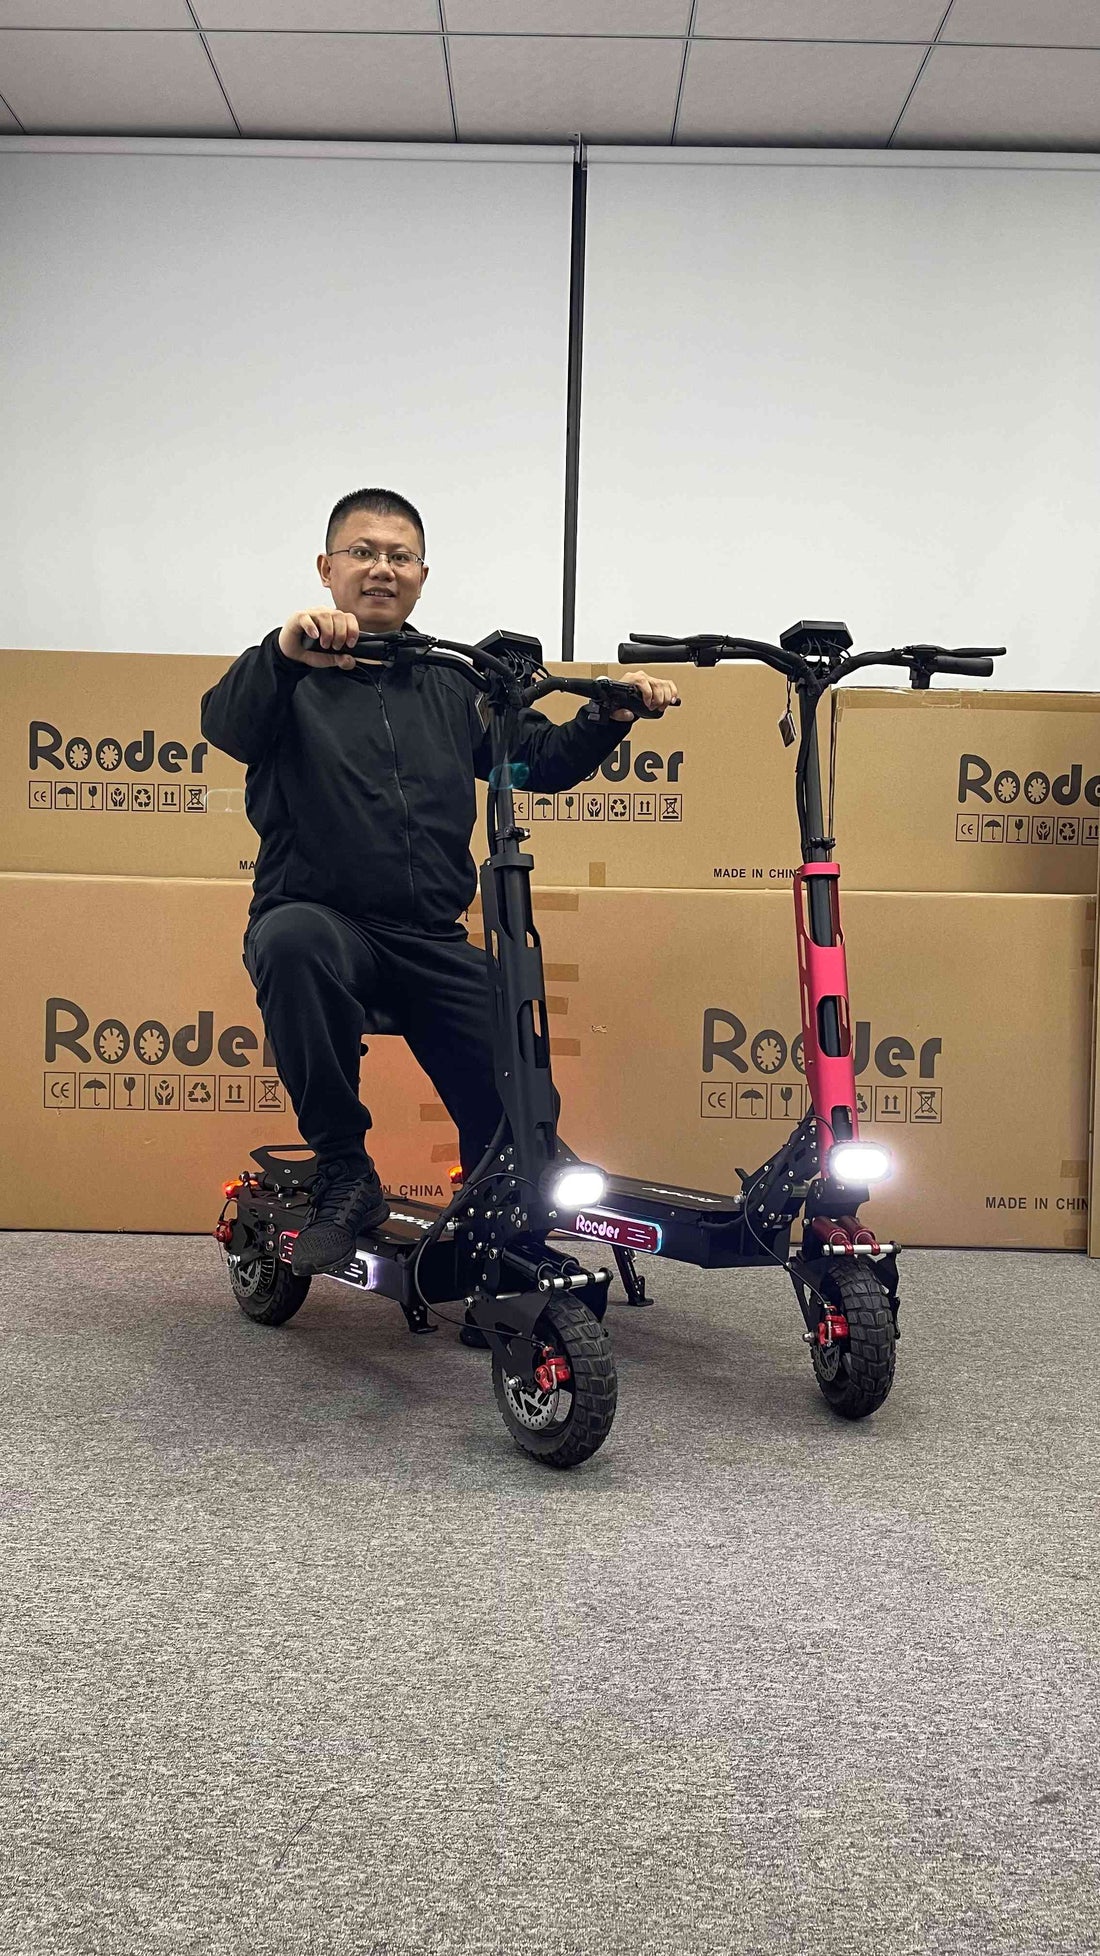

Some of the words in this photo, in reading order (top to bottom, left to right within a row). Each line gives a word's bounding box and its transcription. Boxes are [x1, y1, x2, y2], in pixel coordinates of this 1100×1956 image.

[29, 721, 208, 773] Rooder
[583, 741, 684, 782] der
[239, 860, 255, 870] MA
[713, 868, 746, 878] MADE
[752, 868, 763, 878] IN
[769, 868, 797, 879] CHIN
[399, 1184, 444, 1197] CHINA
[985, 1196, 1027, 1209] MADE
[1034, 1197, 1048, 1210] IN
[1056, 1197, 1089, 1210] CHIN
